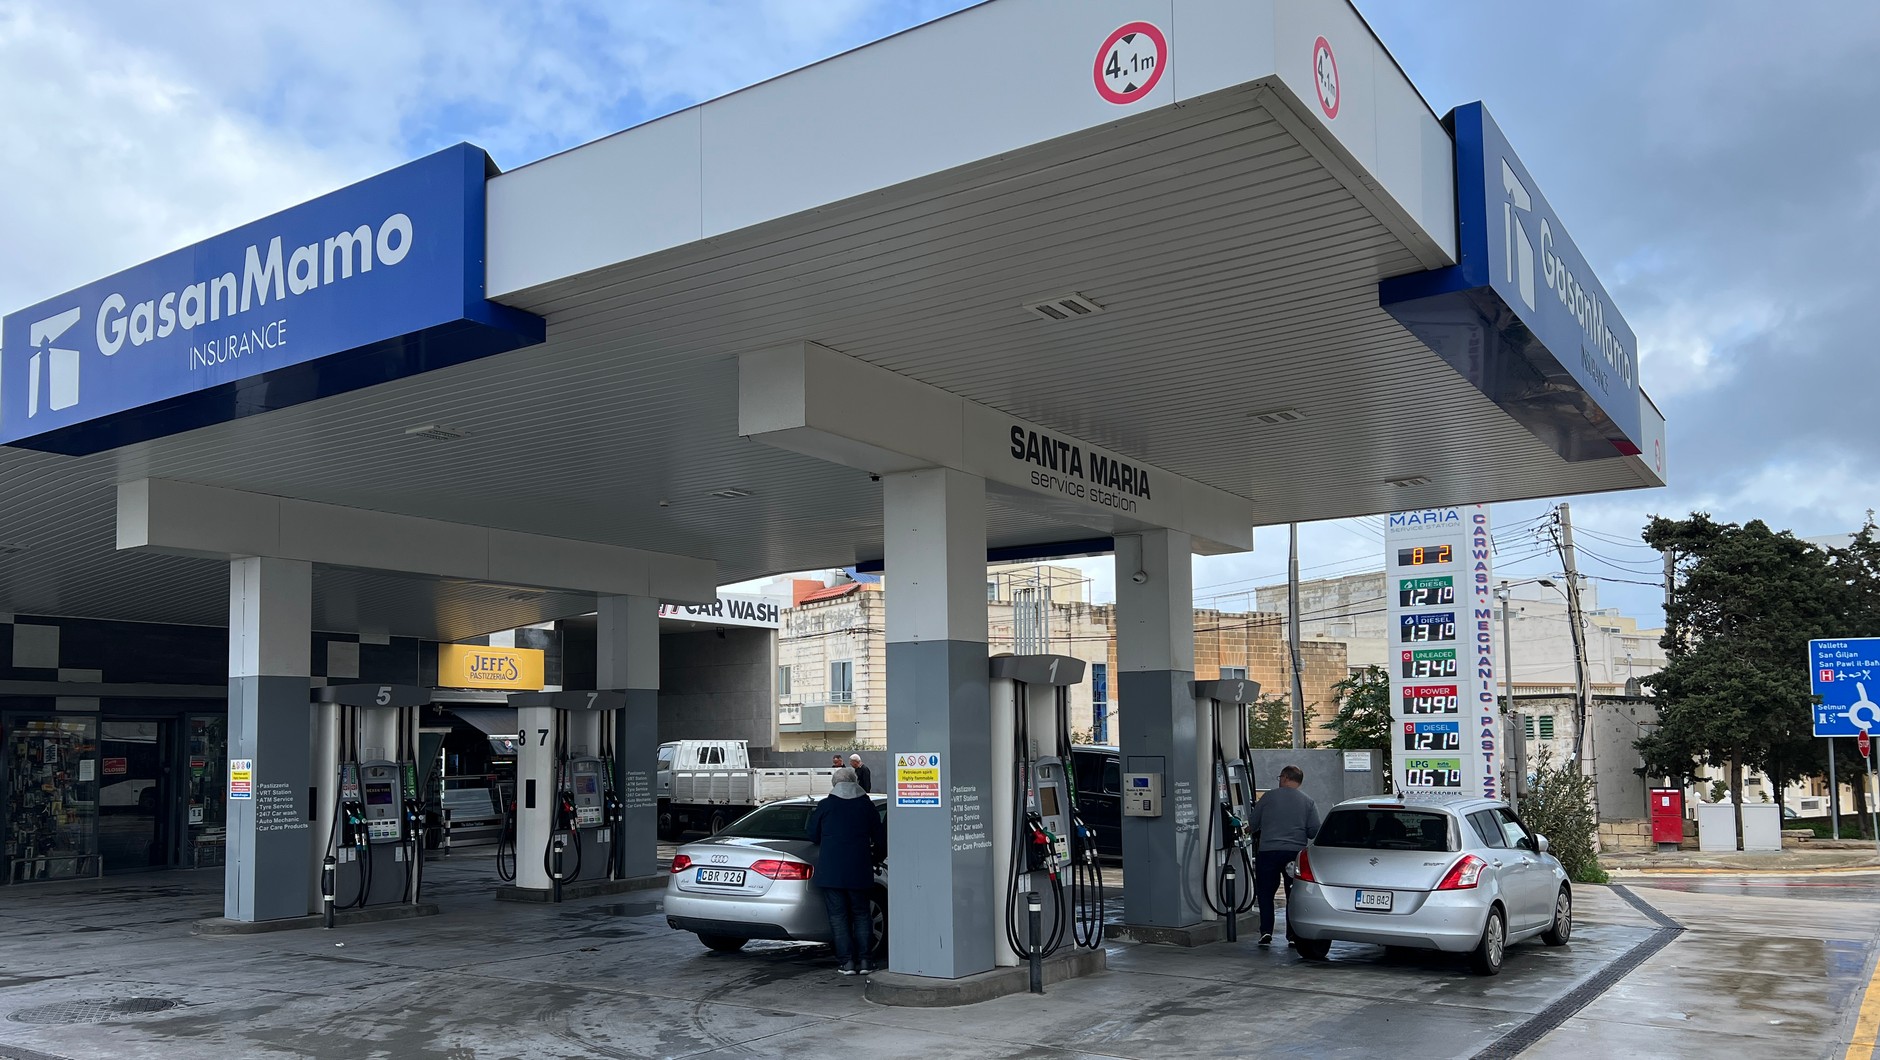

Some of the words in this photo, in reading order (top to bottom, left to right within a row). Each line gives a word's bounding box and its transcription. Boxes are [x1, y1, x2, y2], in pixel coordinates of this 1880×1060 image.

[96, 213, 413, 356] GasanMamo
[1540, 217, 1632, 389] GasanMamo
[189, 319, 287, 372] INSURANCE
[1010, 425, 1084, 479] SANTA
[1090, 452, 1151, 500] MARIA
[1031, 470, 1085, 498] service
[1090, 487, 1137, 514] station
[1390, 510, 1459, 527] MARIA
[1390, 525, 1423, 533] SERVICE
[1425, 522, 1460, 530] STATION
[1412, 547, 1424, 565] 8
[1438, 545, 1449, 563] 2
[1419, 580, 1449, 588] DIESEL
[727, 599, 778, 623] WASH
[1421, 616, 1451, 624] DIESEL
[1475, 608, 1493, 703] MECHANIC
[1856, 659, 1880, 667] il-Baħ
[470, 672, 506, 680] PASTIZZERIA
[1049, 658, 1059, 683] 1
[376, 686, 392, 705] 5
[1235, 681, 1244, 702] 3
[586, 692, 598, 709] 7
[518, 730, 526, 746] 8
[537, 729, 549, 746] 7
[954, 815, 963, 823] Tyre
[963, 823, 971, 831] Car
[965, 832, 985, 840] Mechanic
[973, 841, 992, 849] Products
[702, 871, 719, 881] CBR
[723, 872, 741, 882] 926
[1376, 895, 1389, 905] 842
